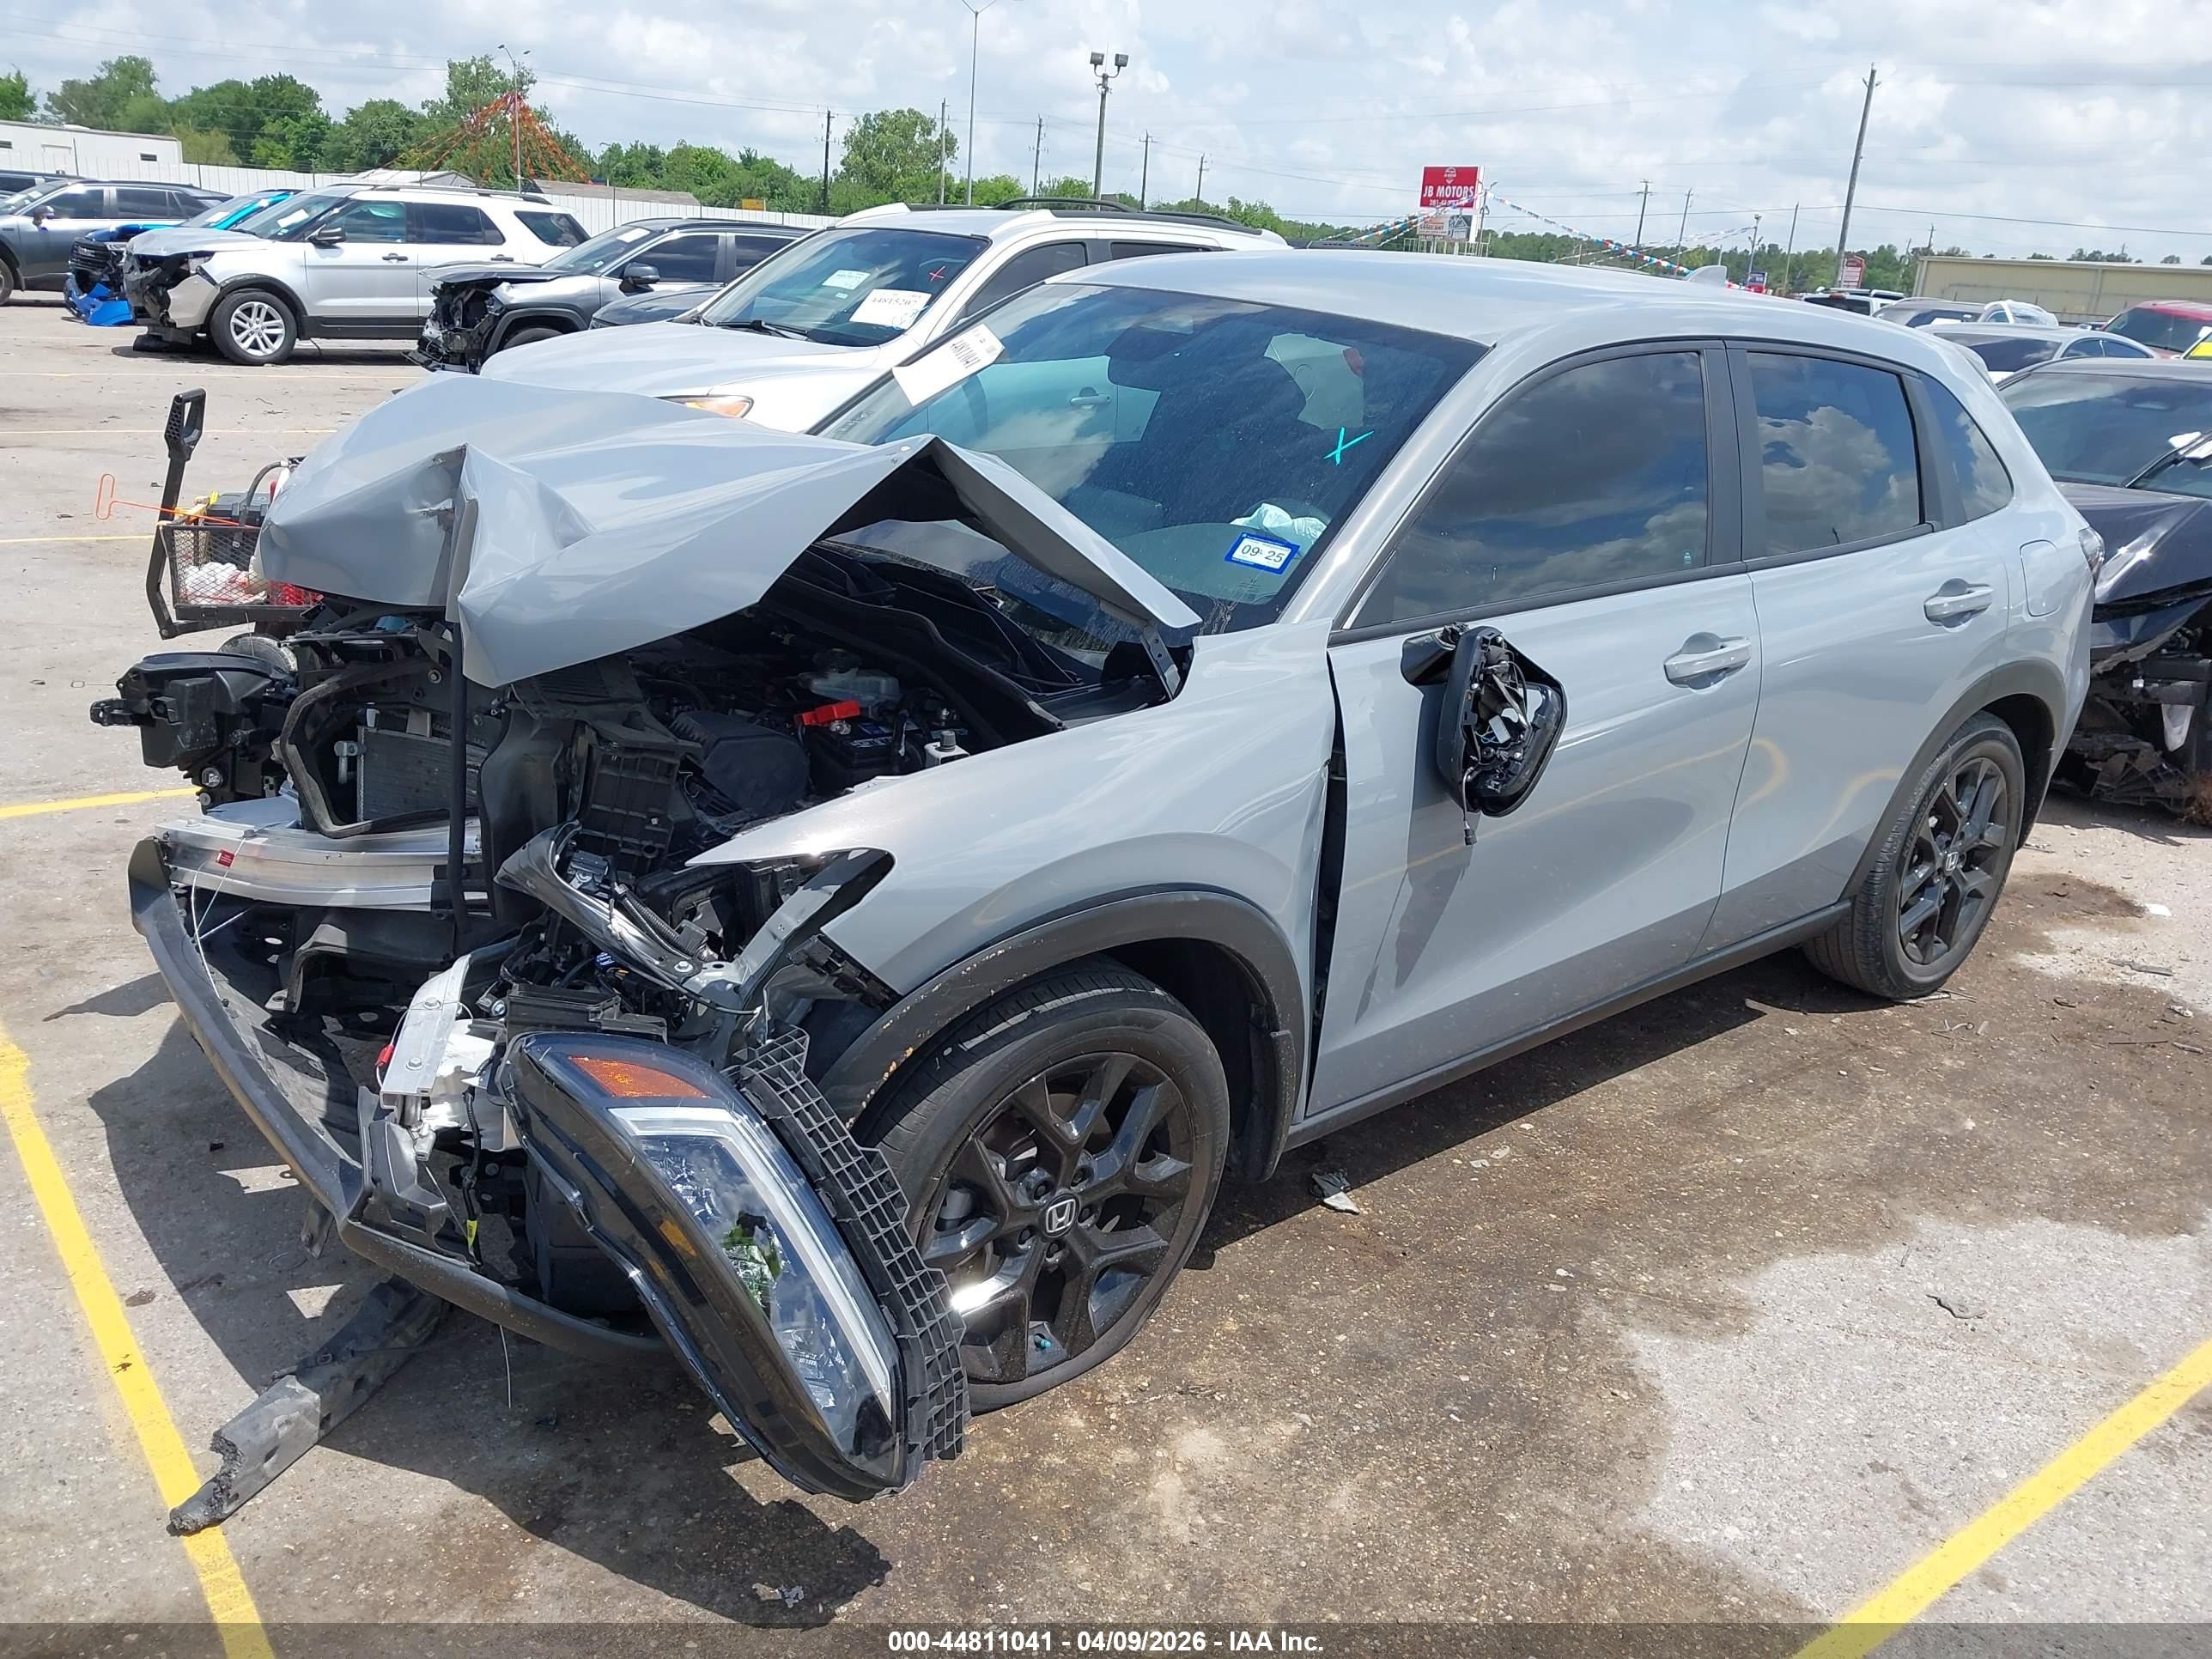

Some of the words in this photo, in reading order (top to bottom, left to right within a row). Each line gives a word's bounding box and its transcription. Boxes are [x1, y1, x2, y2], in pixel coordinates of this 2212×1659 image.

[1423, 185, 1434, 197] JB
[1436, 185, 1474, 198] MOTORS
[1242, 544, 1261, 556] 09
[1264, 550, 1285, 563] 25
